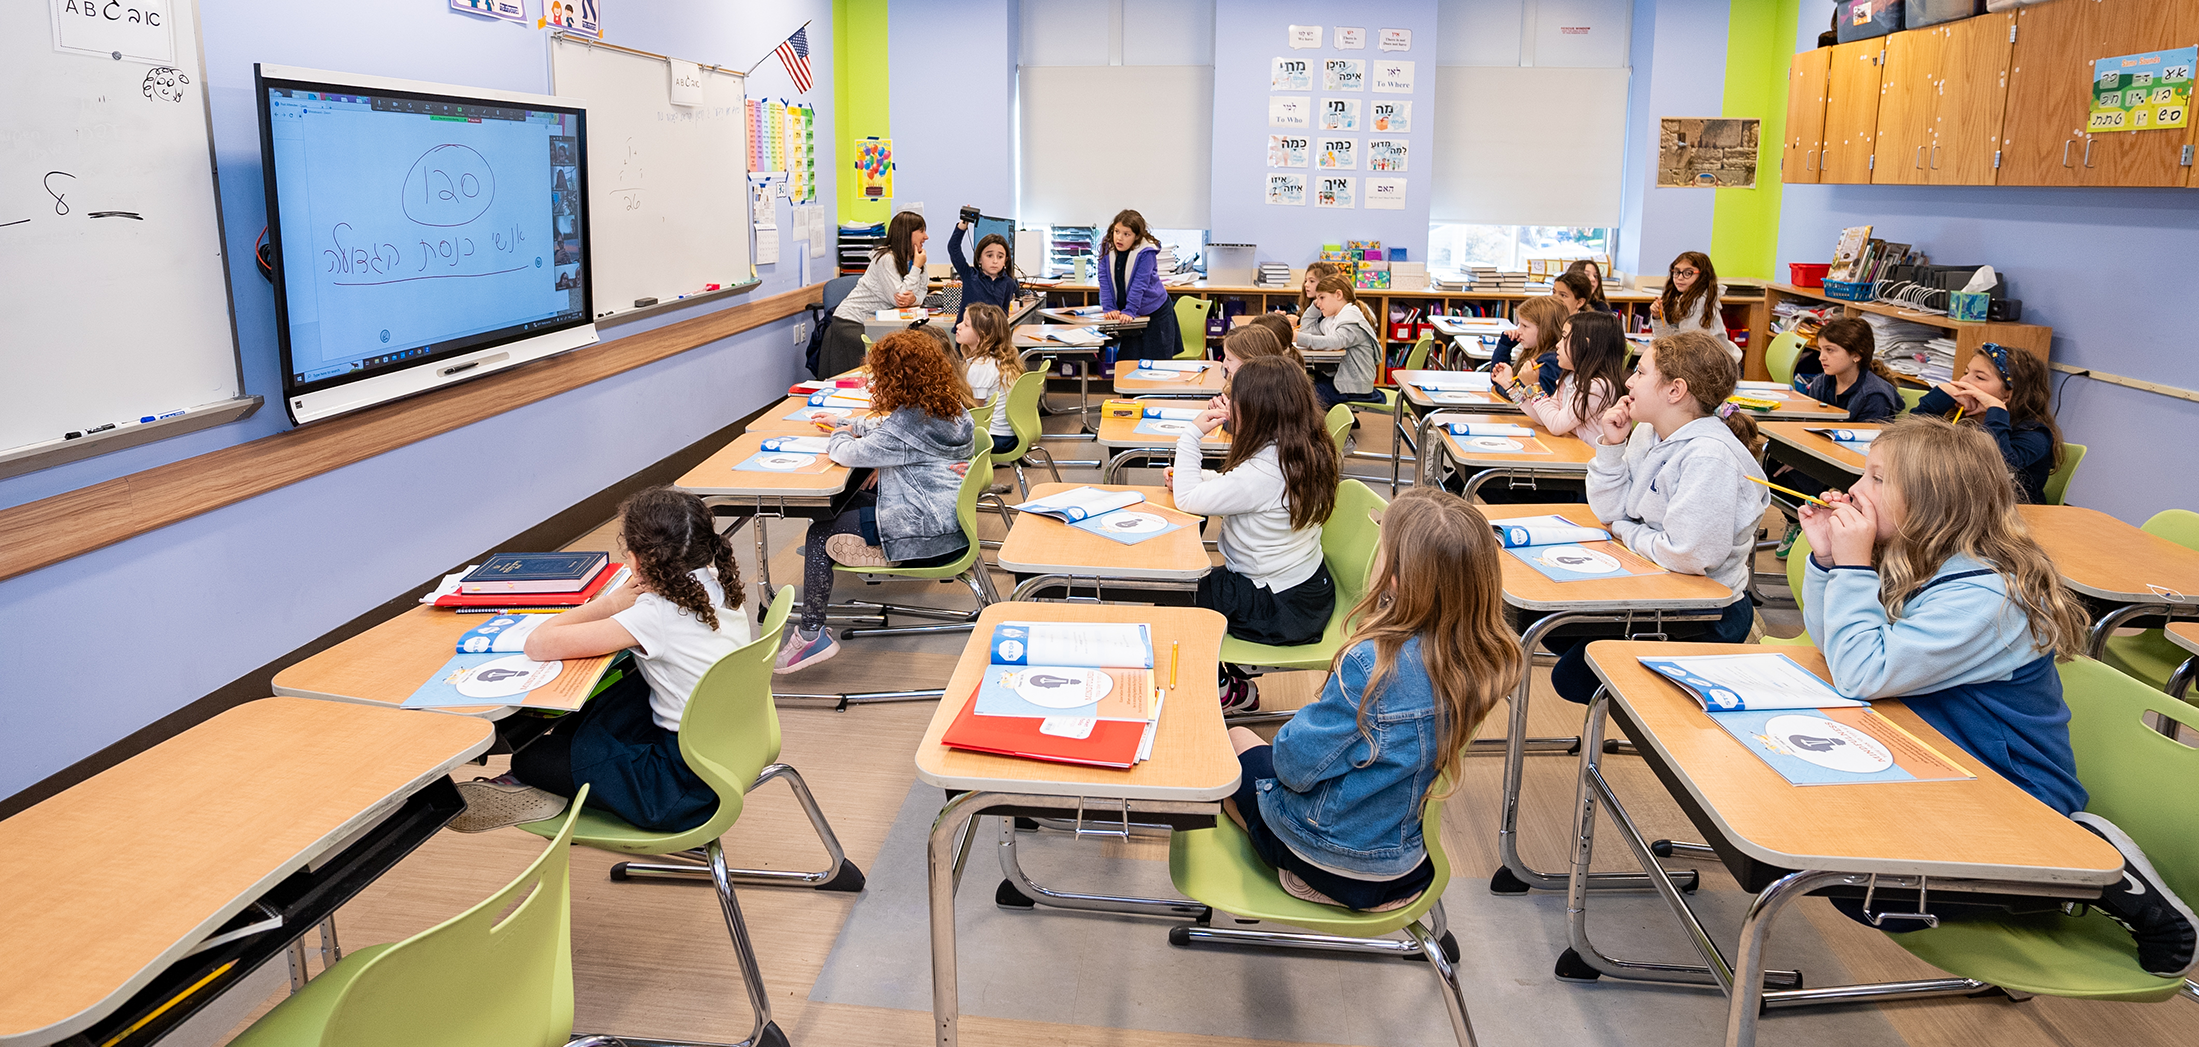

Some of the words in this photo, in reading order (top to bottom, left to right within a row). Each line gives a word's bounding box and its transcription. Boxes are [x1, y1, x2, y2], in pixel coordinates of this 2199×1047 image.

[2121, 59, 2138, 67] Same
[2139, 55, 2161, 65] Sounds
[1387, 81, 1410, 89] Where
[423, 166, 480, 204] 120
[623, 193, 641, 211] 26
[324, 222, 400, 275] הגדולה
[491, 223, 526, 253] אנשי
[418, 237, 475, 272] כנסת
[1716, 690, 1731, 706] STOP
